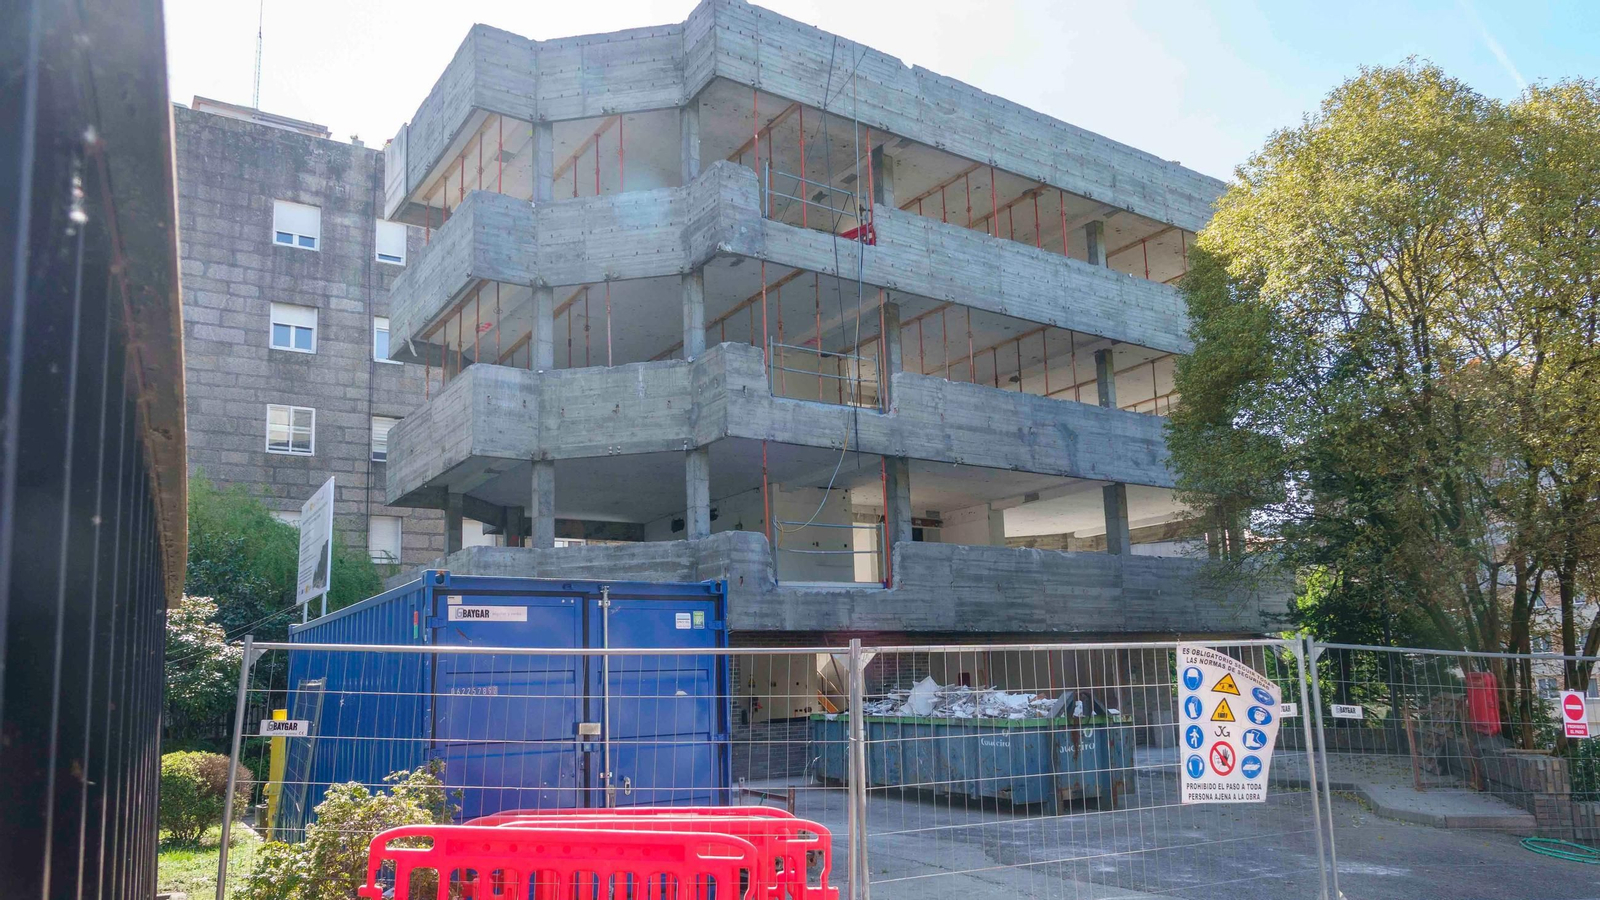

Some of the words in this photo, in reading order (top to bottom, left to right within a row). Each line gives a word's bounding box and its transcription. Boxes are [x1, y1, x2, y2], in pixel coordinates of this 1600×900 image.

[462, 609, 490, 618] BAYGAR
[1182, 647, 1190, 655] ES
[1191, 648, 1233, 665] OBLIGATORIO
[1234, 662, 1256, 677] SEGUIR
[1256, 675, 1275, 689] TODAS
[1199, 658, 1226, 669] NORMAS
[1227, 665, 1235, 673] DE
[1237, 670, 1270, 691] SEGURIDAD
[273, 722, 298, 731] BAYGAR
[1188, 793, 1213, 801] PERSONA
